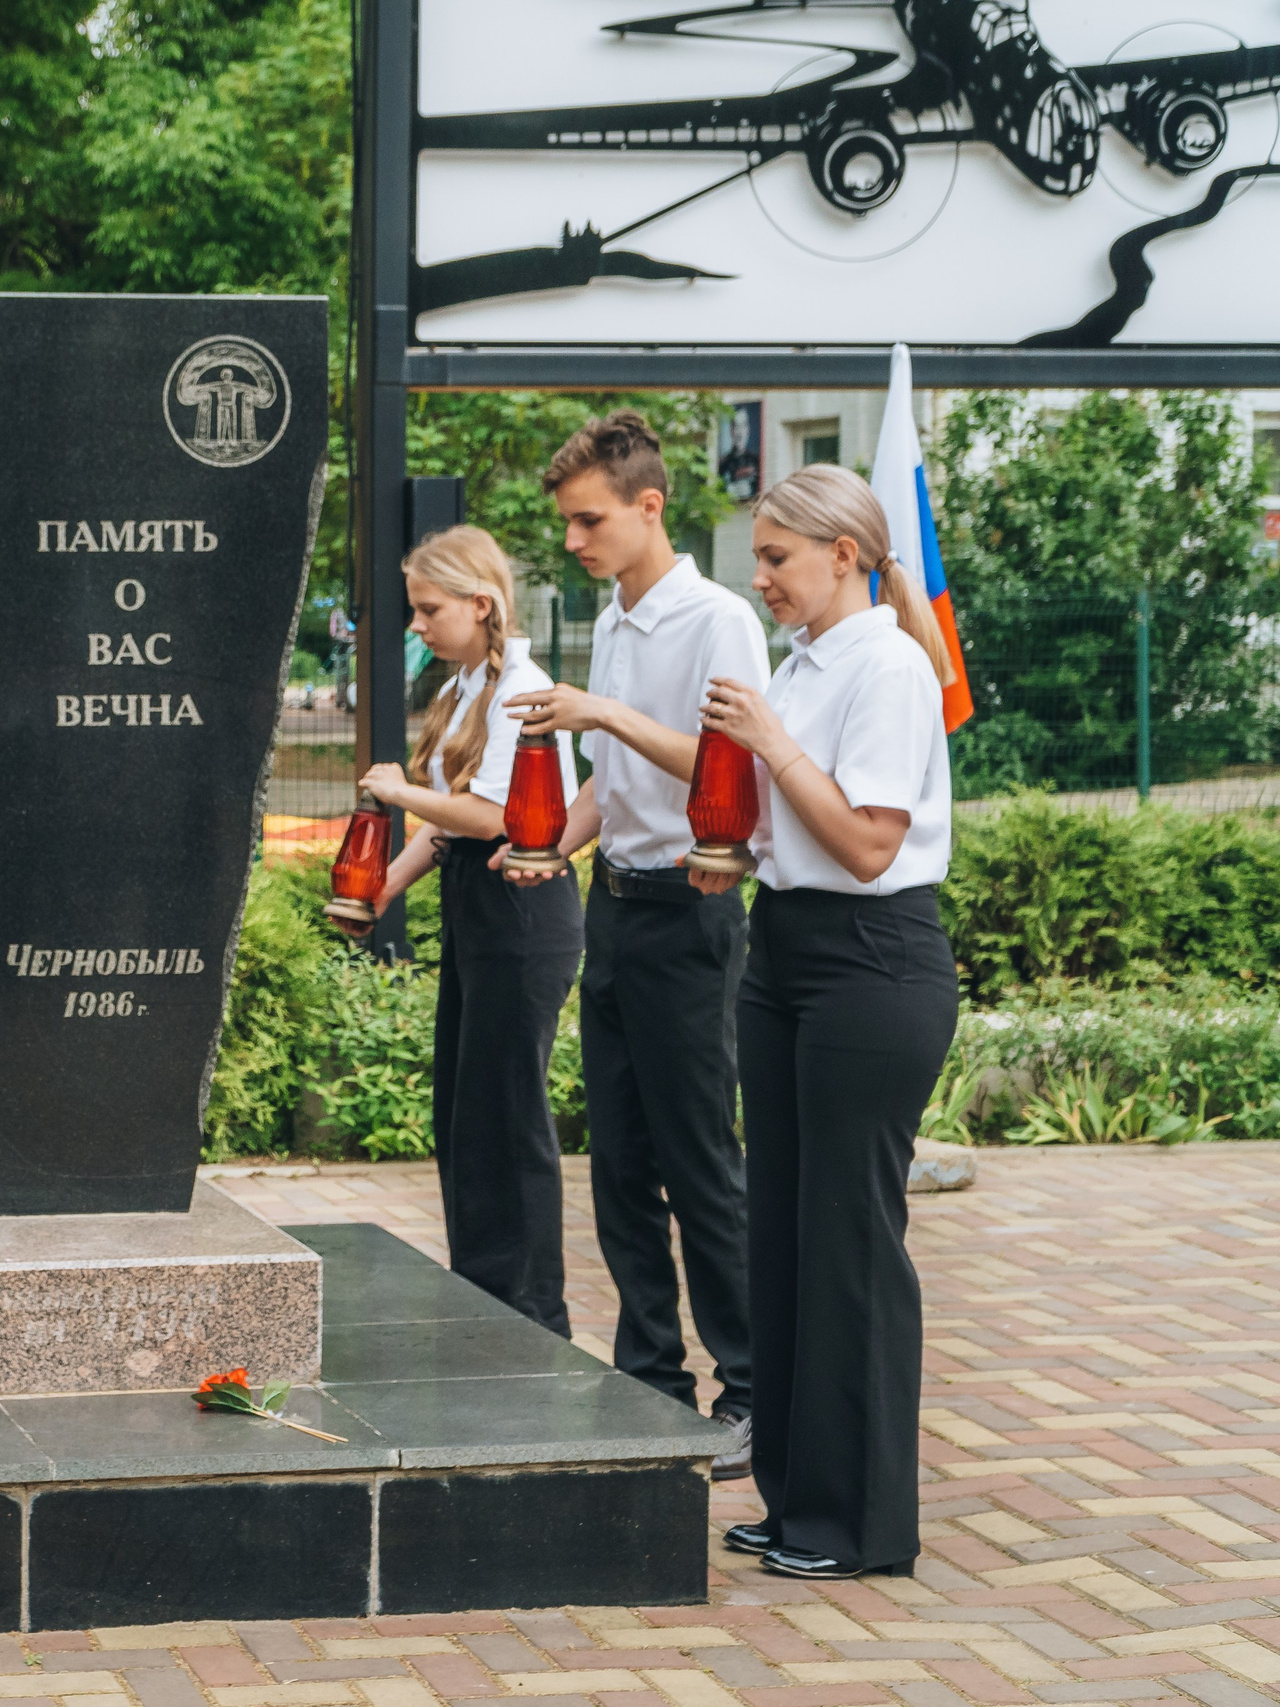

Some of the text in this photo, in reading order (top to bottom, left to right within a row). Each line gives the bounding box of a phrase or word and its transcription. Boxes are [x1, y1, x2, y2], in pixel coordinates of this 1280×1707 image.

[37, 519, 219, 553] ПАМЯТЬ
[114, 578, 147, 612] О
[87, 632, 173, 666] ВАС
[55, 693, 204, 727] ВЕЧНА
[6, 943, 206, 977] ЧЕРНОБЫЛЬ
[63, 991, 135, 1018] 1986
